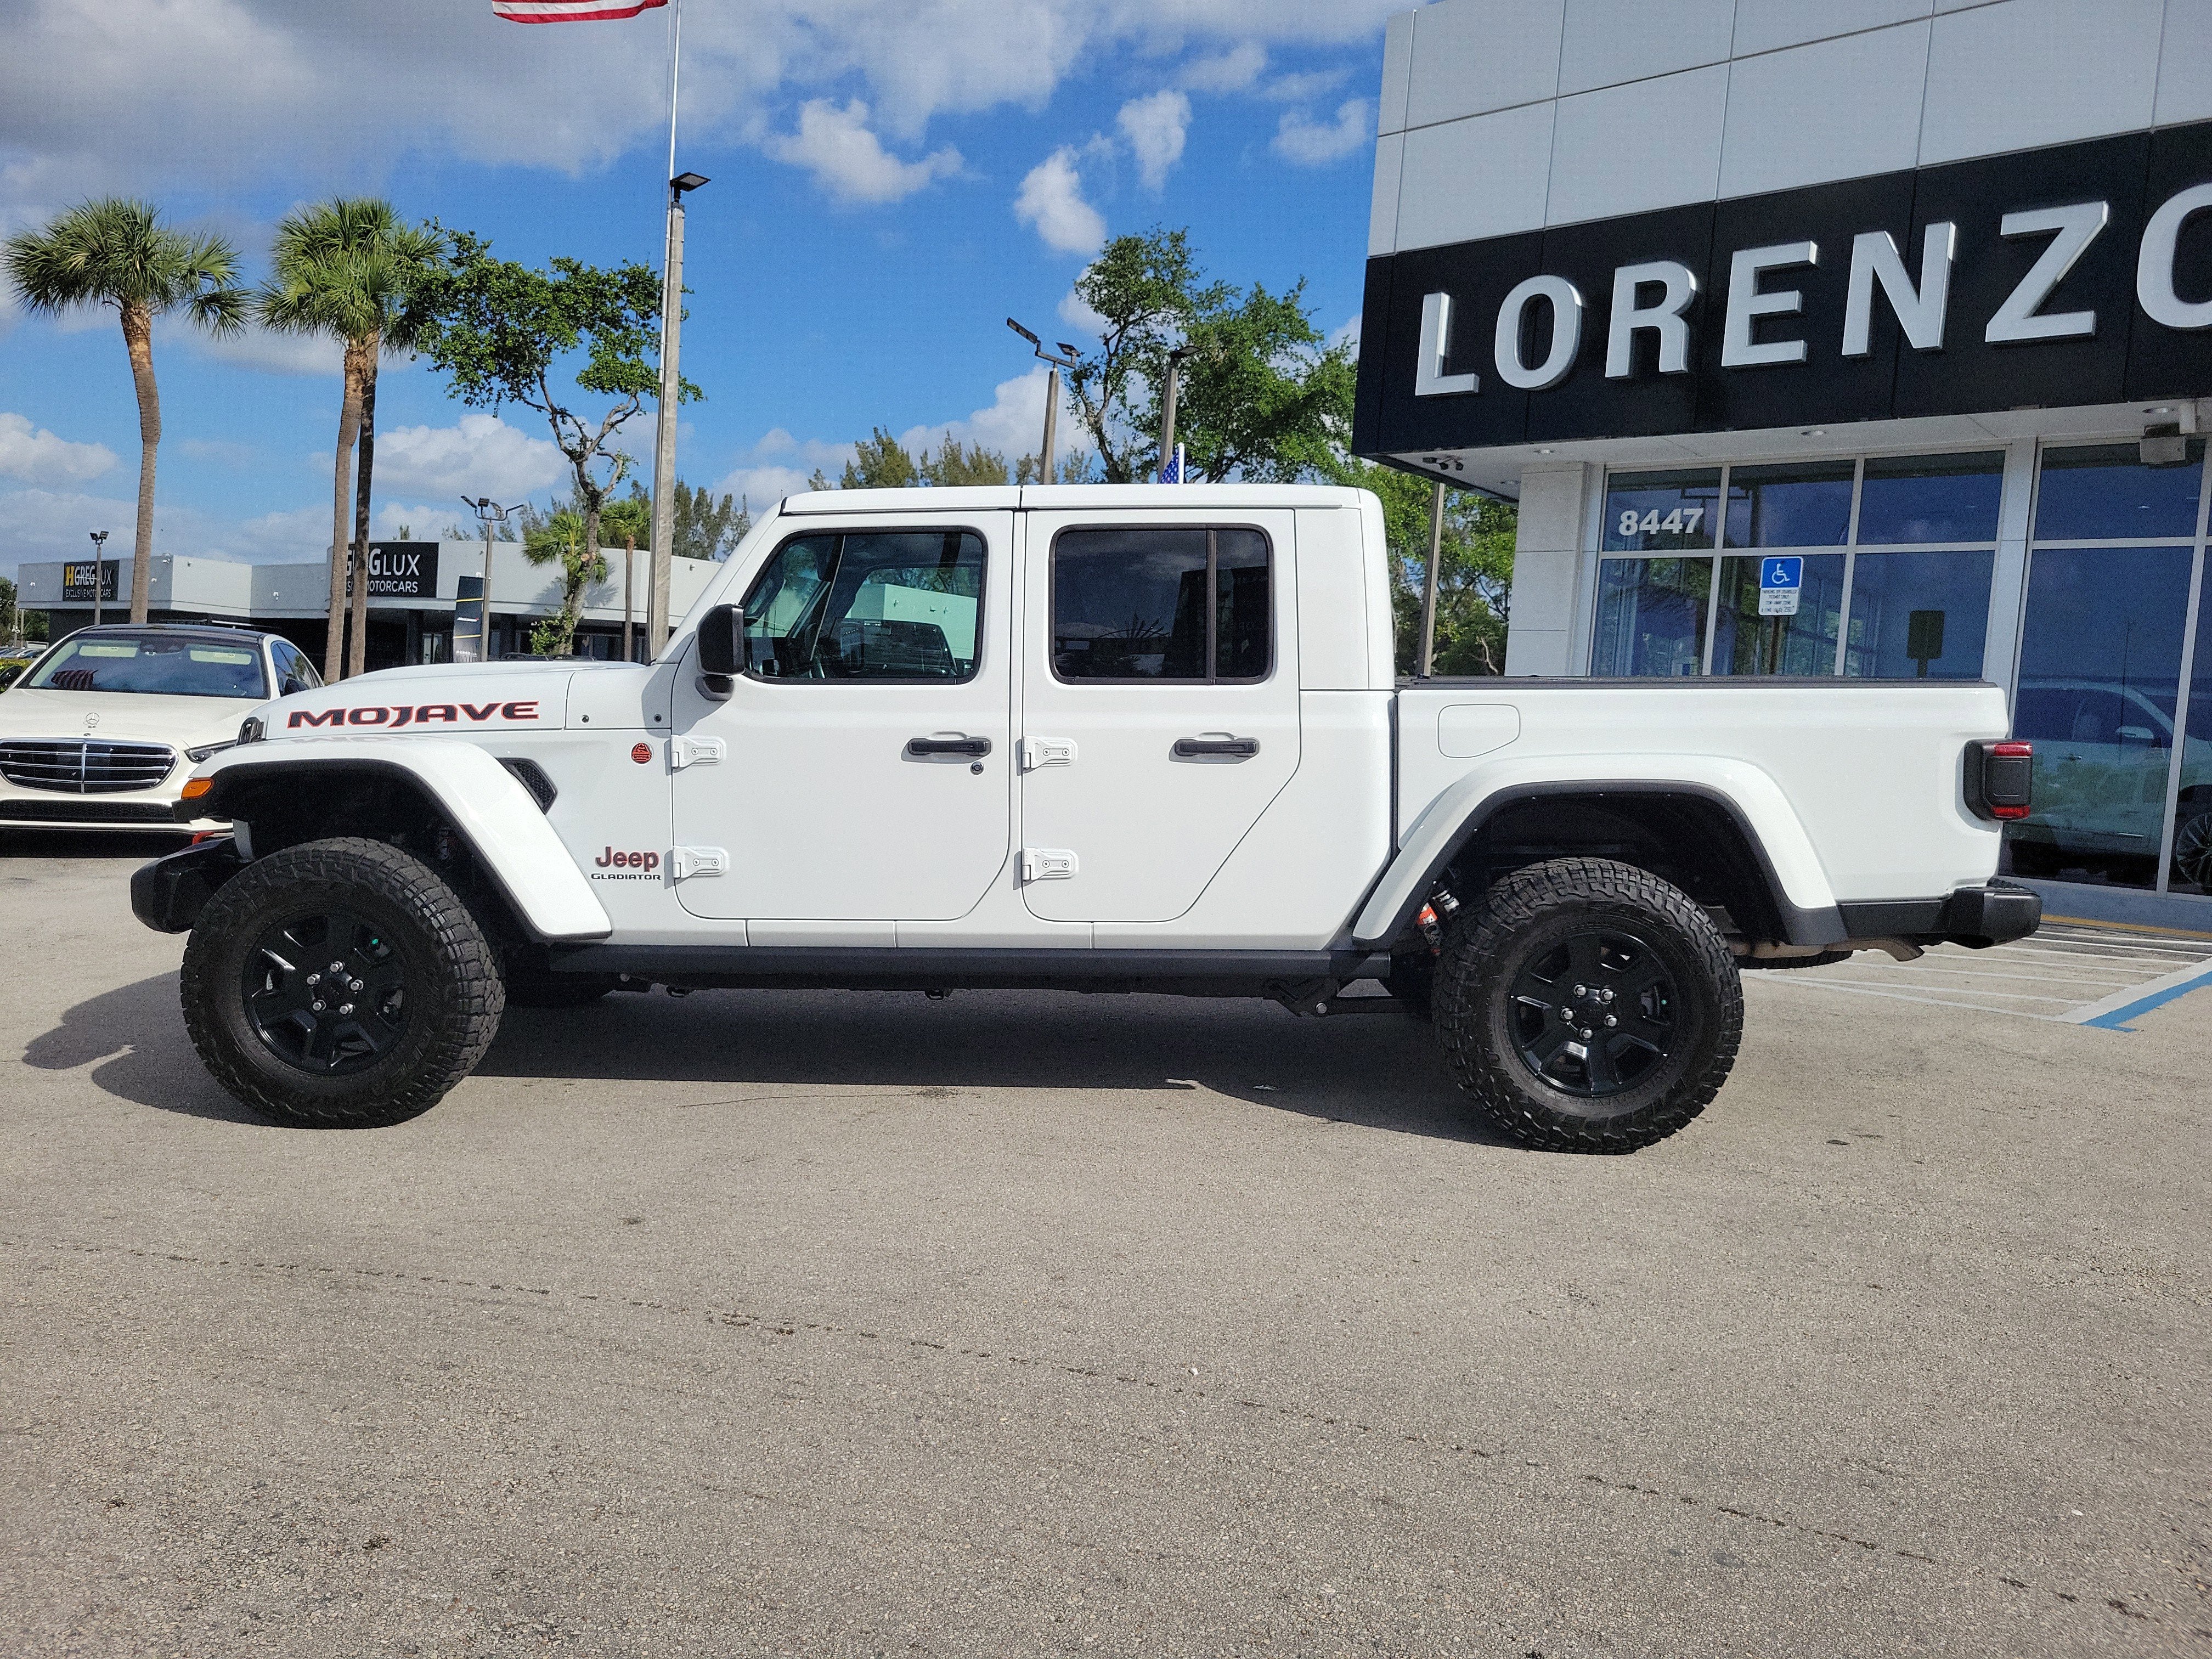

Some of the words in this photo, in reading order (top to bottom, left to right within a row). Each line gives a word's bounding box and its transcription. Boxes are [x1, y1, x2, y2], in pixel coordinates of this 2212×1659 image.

[1414, 183, 2212, 397] LORENZO
[1618, 508, 1704, 537] 8447
[65, 565, 112, 586] HGREGUX
[367, 580, 418, 593] OTORCARS
[287, 701, 539, 729] MOJAVE
[595, 846, 659, 872] Jeep
